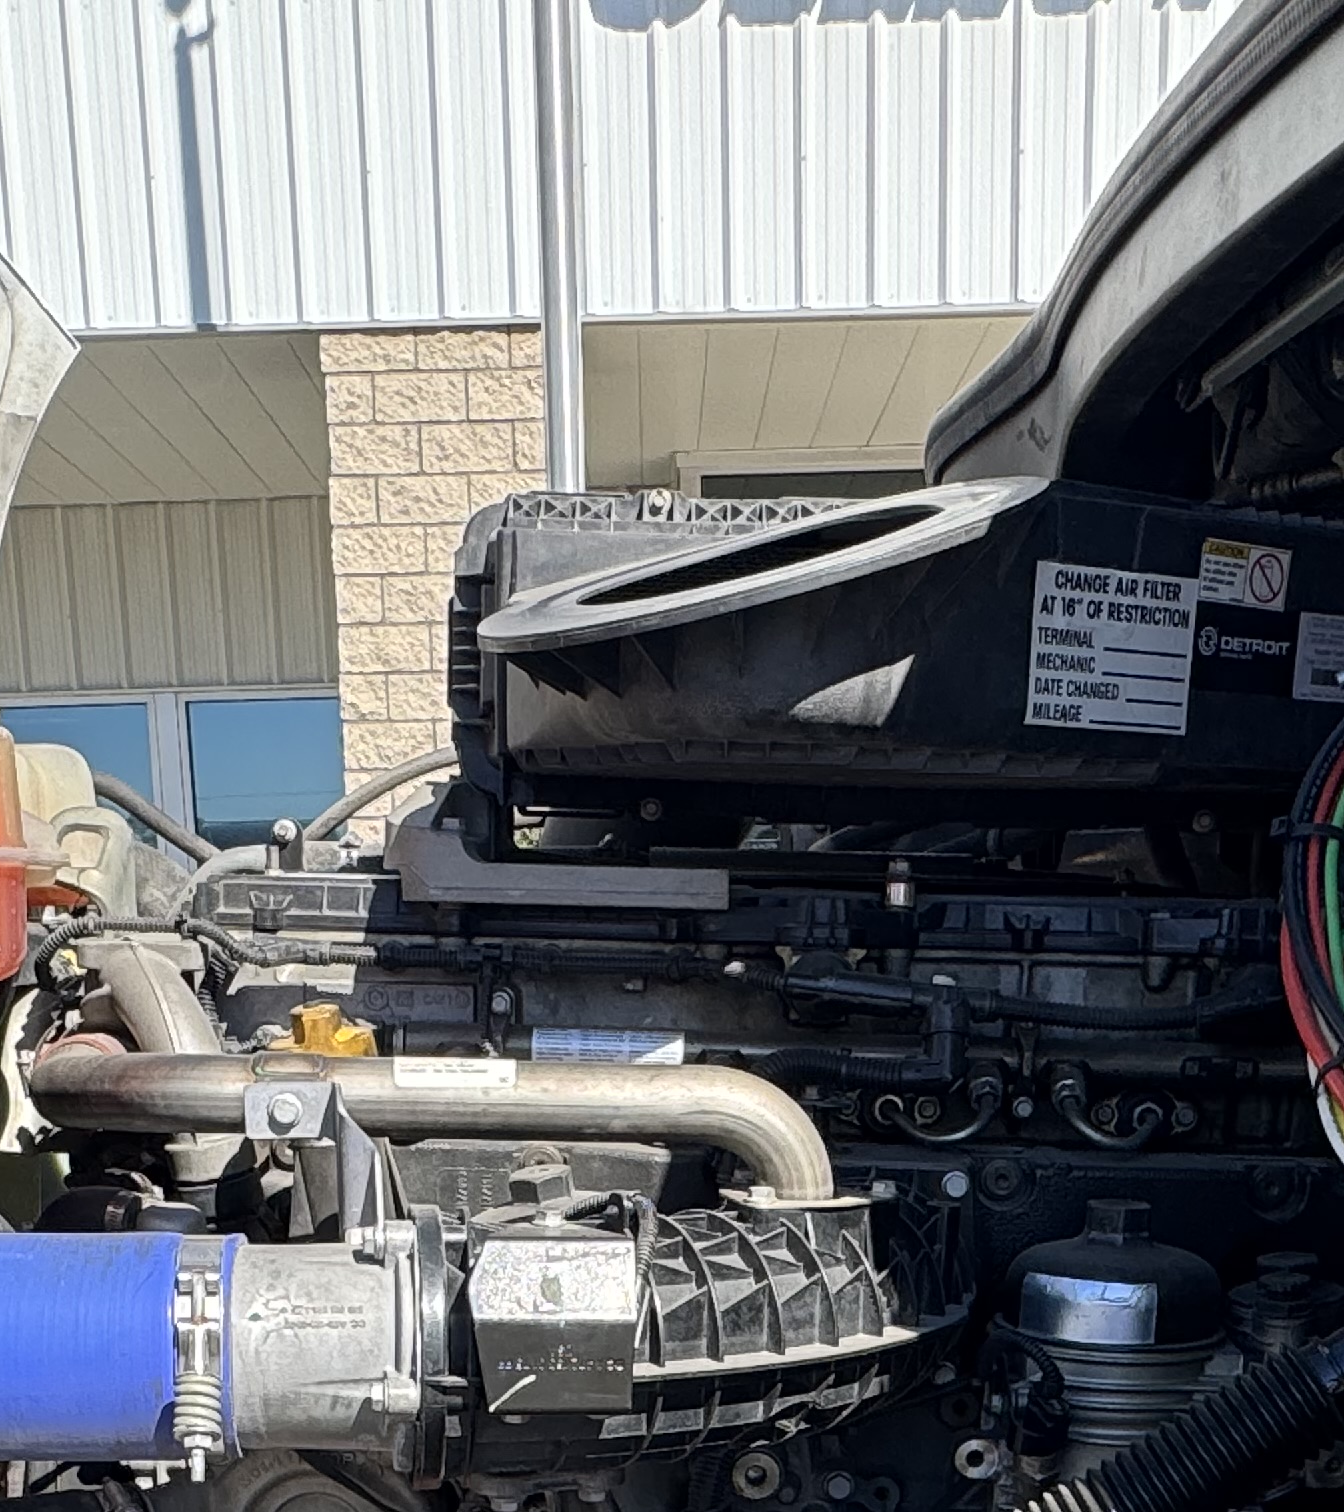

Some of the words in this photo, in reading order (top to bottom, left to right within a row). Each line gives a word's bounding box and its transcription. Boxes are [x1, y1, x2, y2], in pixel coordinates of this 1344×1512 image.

[1055, 570, 1110, 594] CHANGE
[1114, 576, 1138, 598] AIR
[1143, 579, 1182, 602] FILTER
[1040, 595, 1057, 615] AT
[1086, 601, 1103, 619] OF
[1107, 602, 1190, 629] RESTRICTION
[1037, 626, 1095, 649] TERMINAL
[1220, 636, 1291, 655] DETROIT
[1036, 651, 1096, 674] MECHANIC
[1034, 677, 1063, 697] DATE
[1066, 680, 1120, 700] CHANGED
[1032, 702, 1083, 723] MILEAGE
